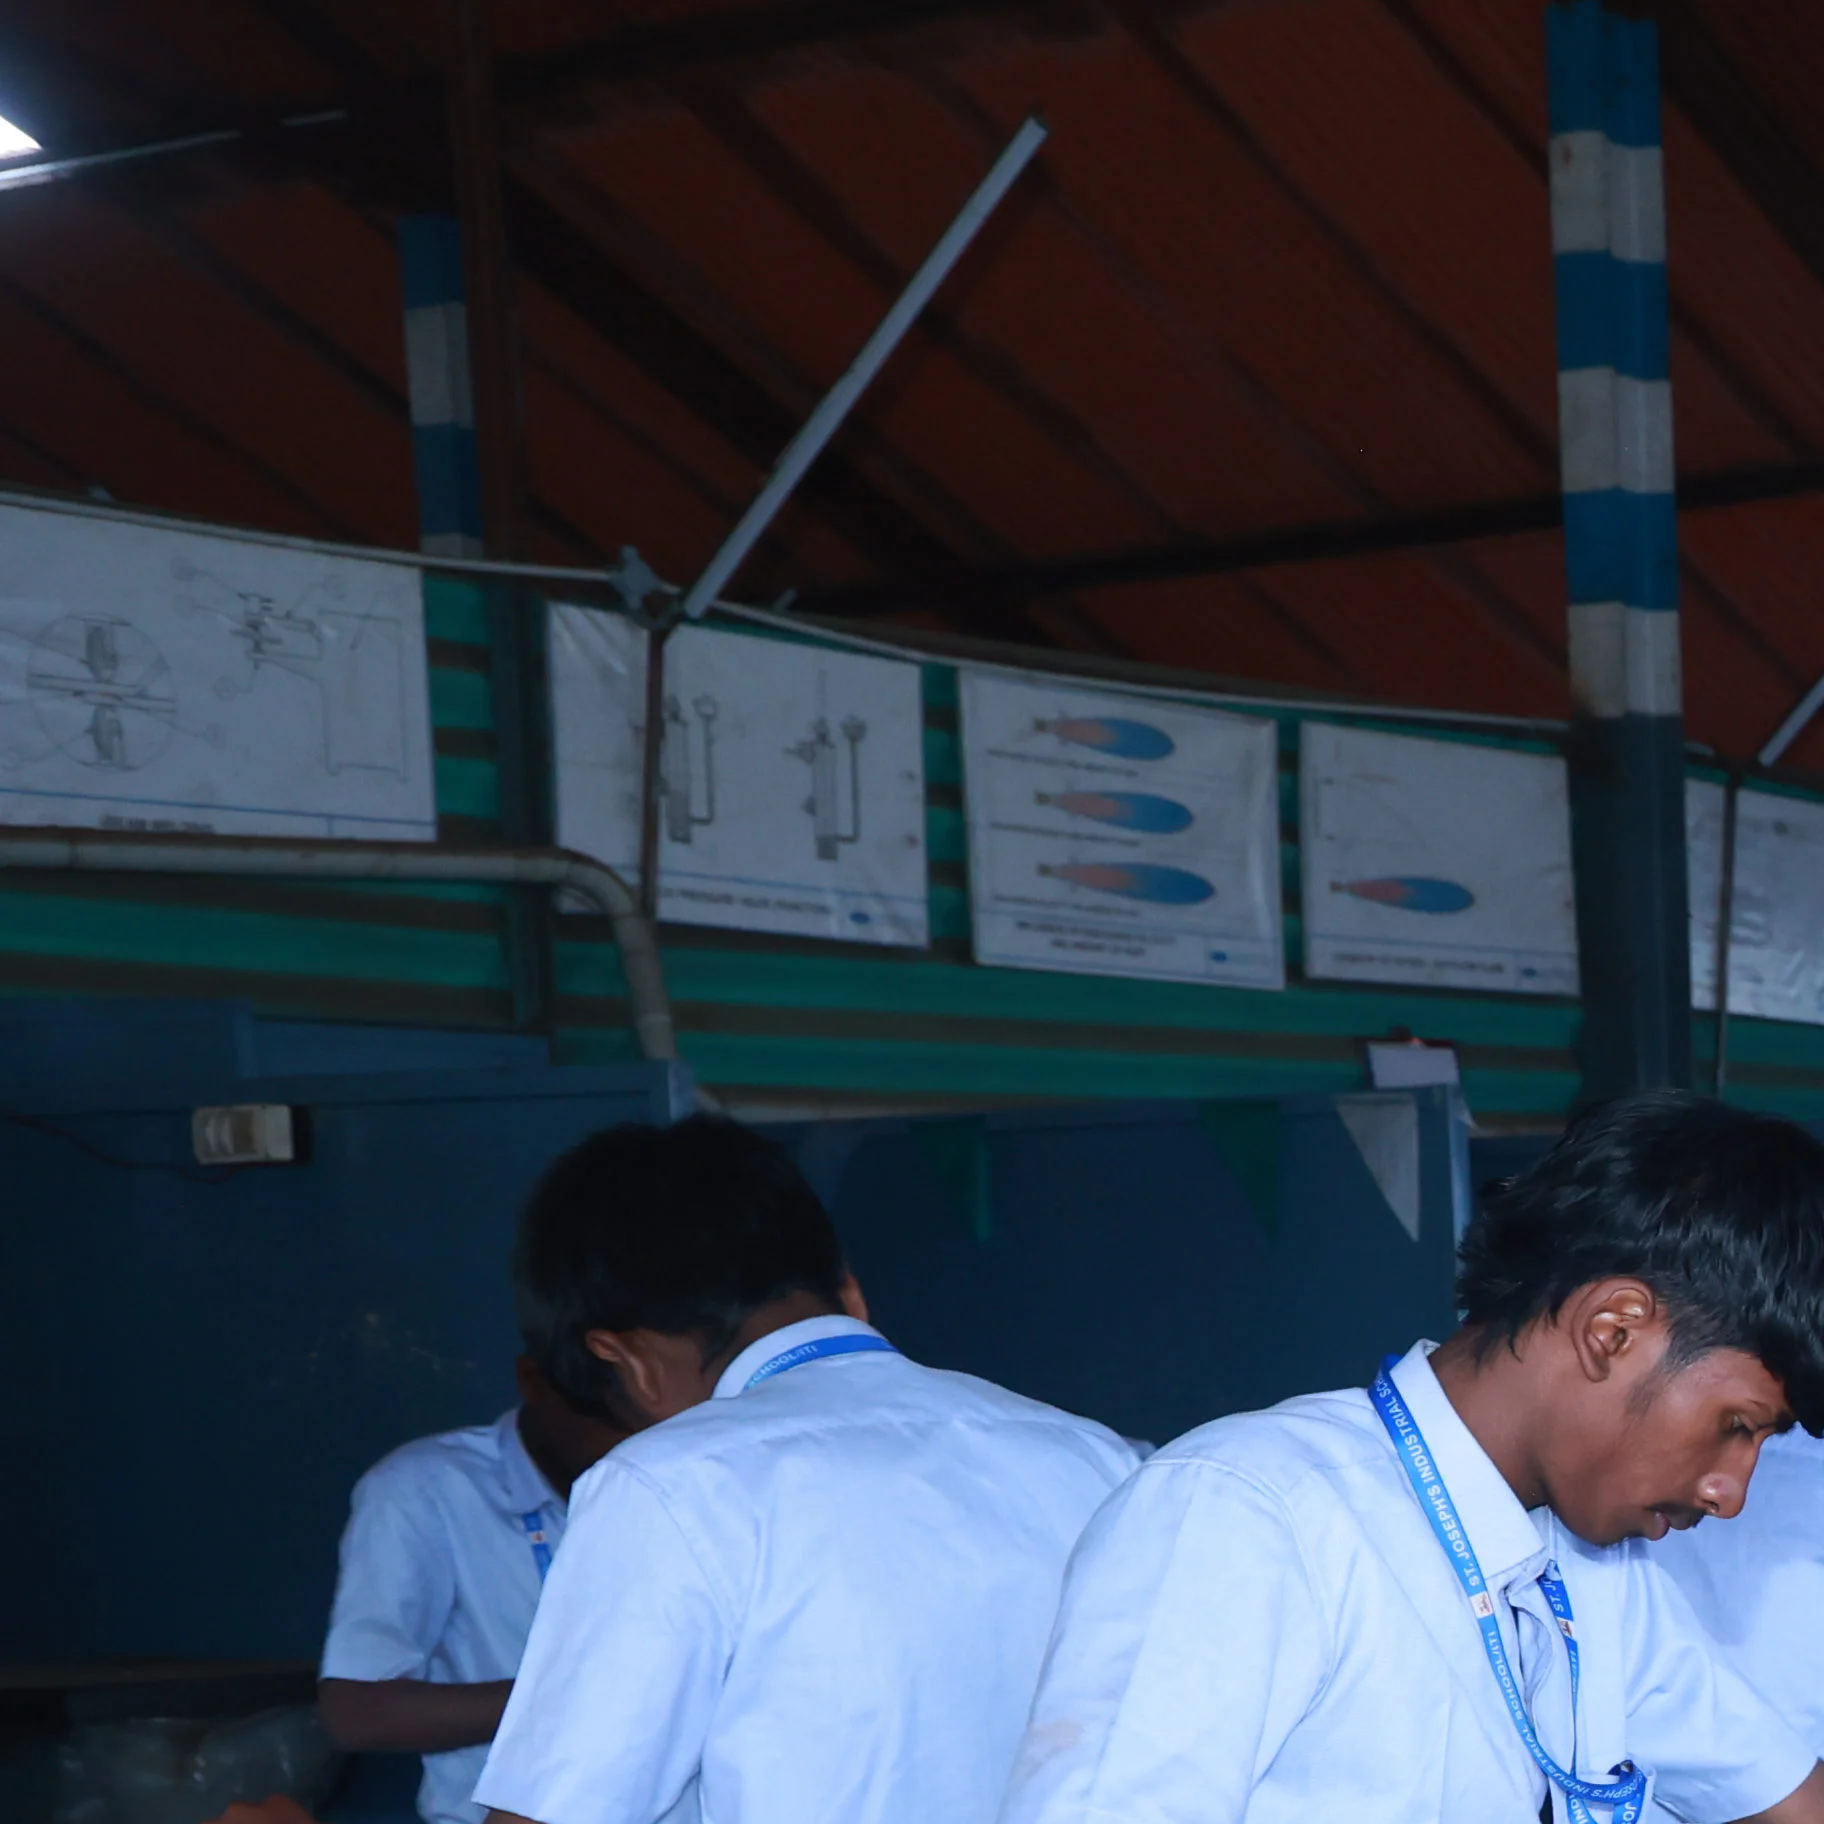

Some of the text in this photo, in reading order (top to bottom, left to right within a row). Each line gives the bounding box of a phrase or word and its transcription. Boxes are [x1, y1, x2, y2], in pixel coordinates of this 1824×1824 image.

[1385, 1396, 1436, 1484] INDUSTRIAL
[1426, 1484, 1470, 1559] JOSEPH'S
[1462, 1561, 1480, 1588] ST.
[1486, 1630, 1523, 1721] SCHOOL/ITI
